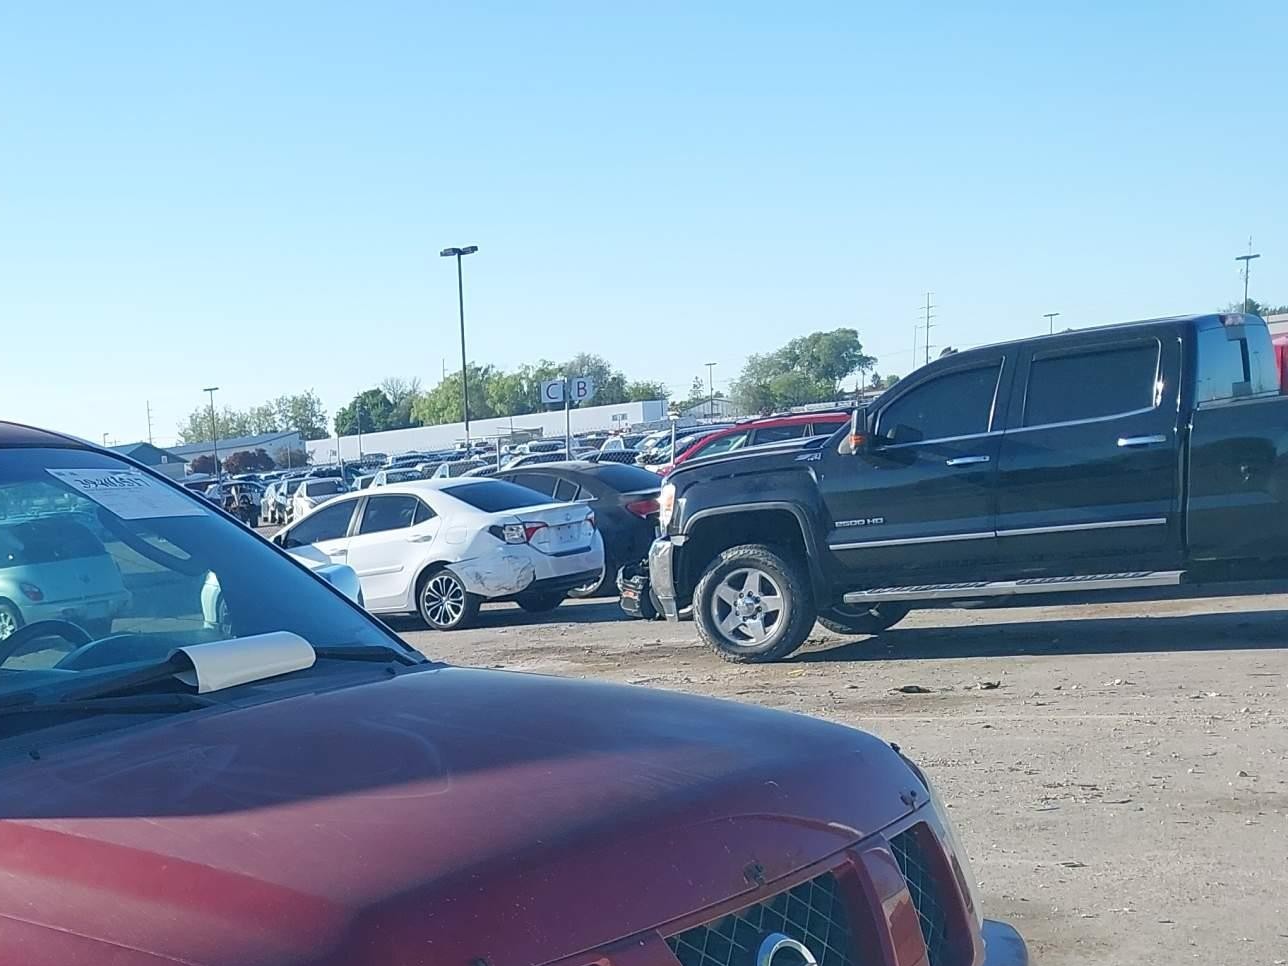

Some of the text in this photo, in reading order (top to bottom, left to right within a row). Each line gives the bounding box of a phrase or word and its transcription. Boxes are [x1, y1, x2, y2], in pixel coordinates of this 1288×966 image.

[547, 383, 559, 399] C
[577, 381, 587, 397] B
[867, 517, 884, 525] HD
